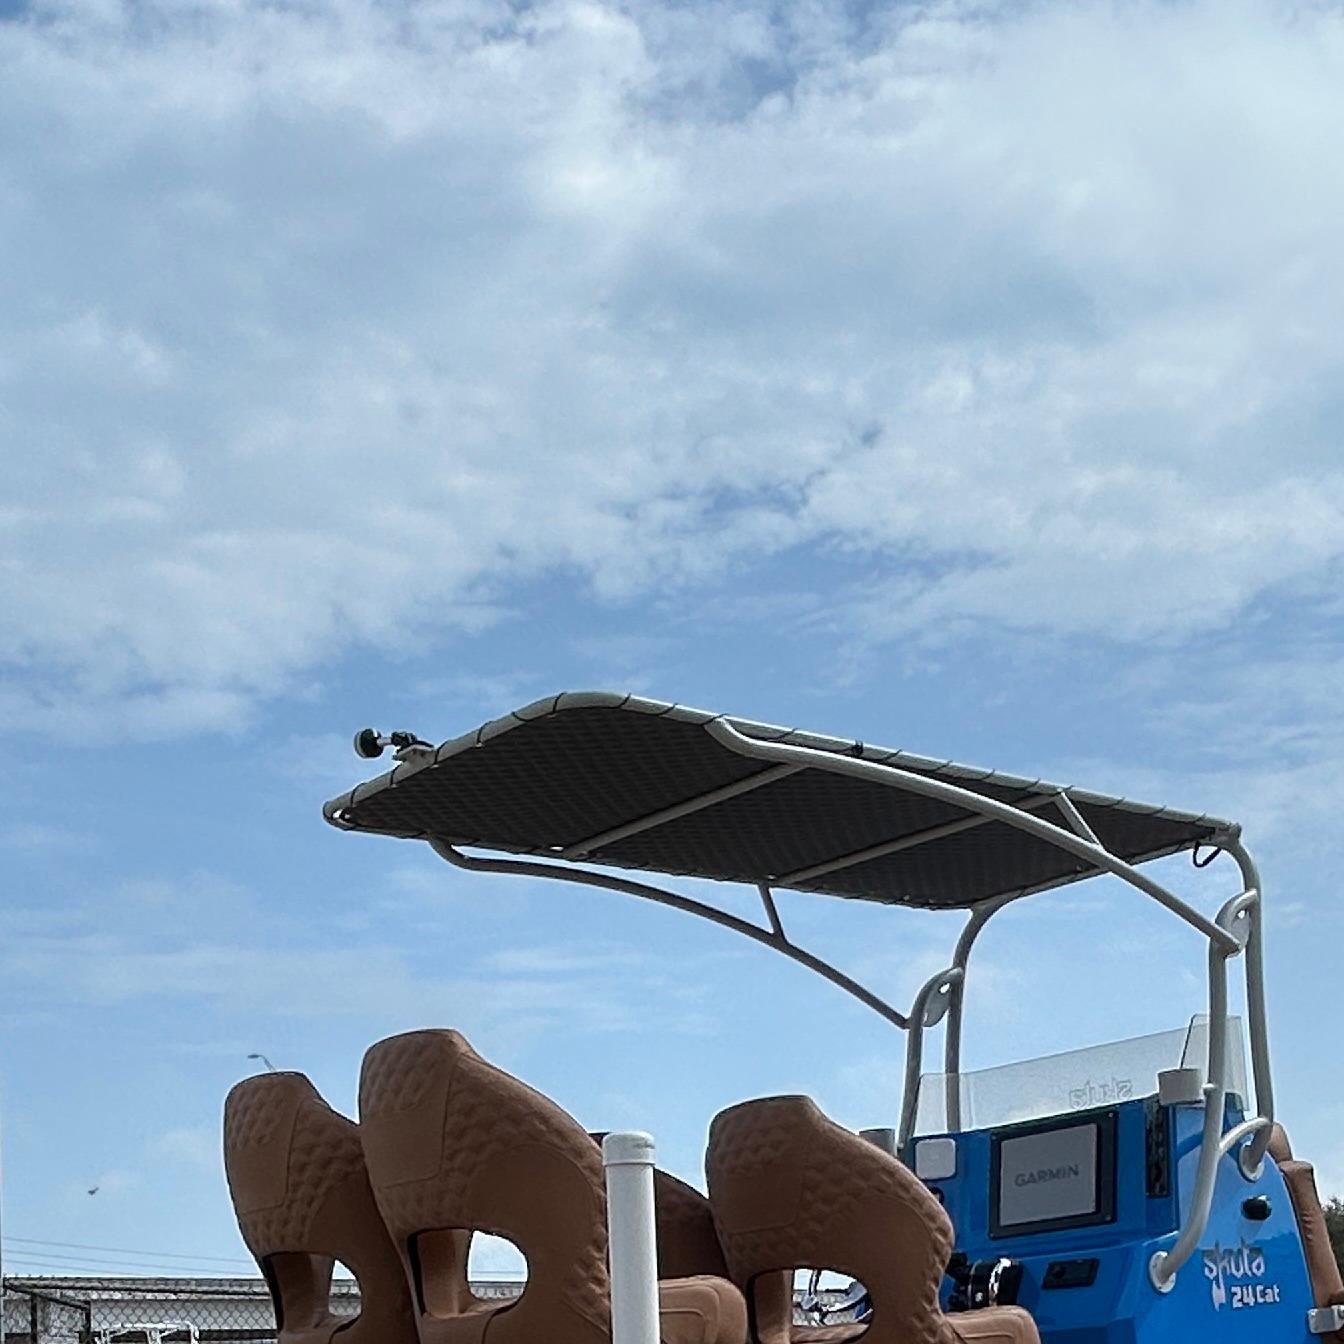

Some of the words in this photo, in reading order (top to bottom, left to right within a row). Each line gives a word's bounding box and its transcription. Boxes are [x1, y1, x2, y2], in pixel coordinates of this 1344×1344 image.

[1015, 1164, 1079, 1187] GARMIN
[1231, 1284, 1255, 1308] 24
[1256, 1282, 1280, 1303] Cat
